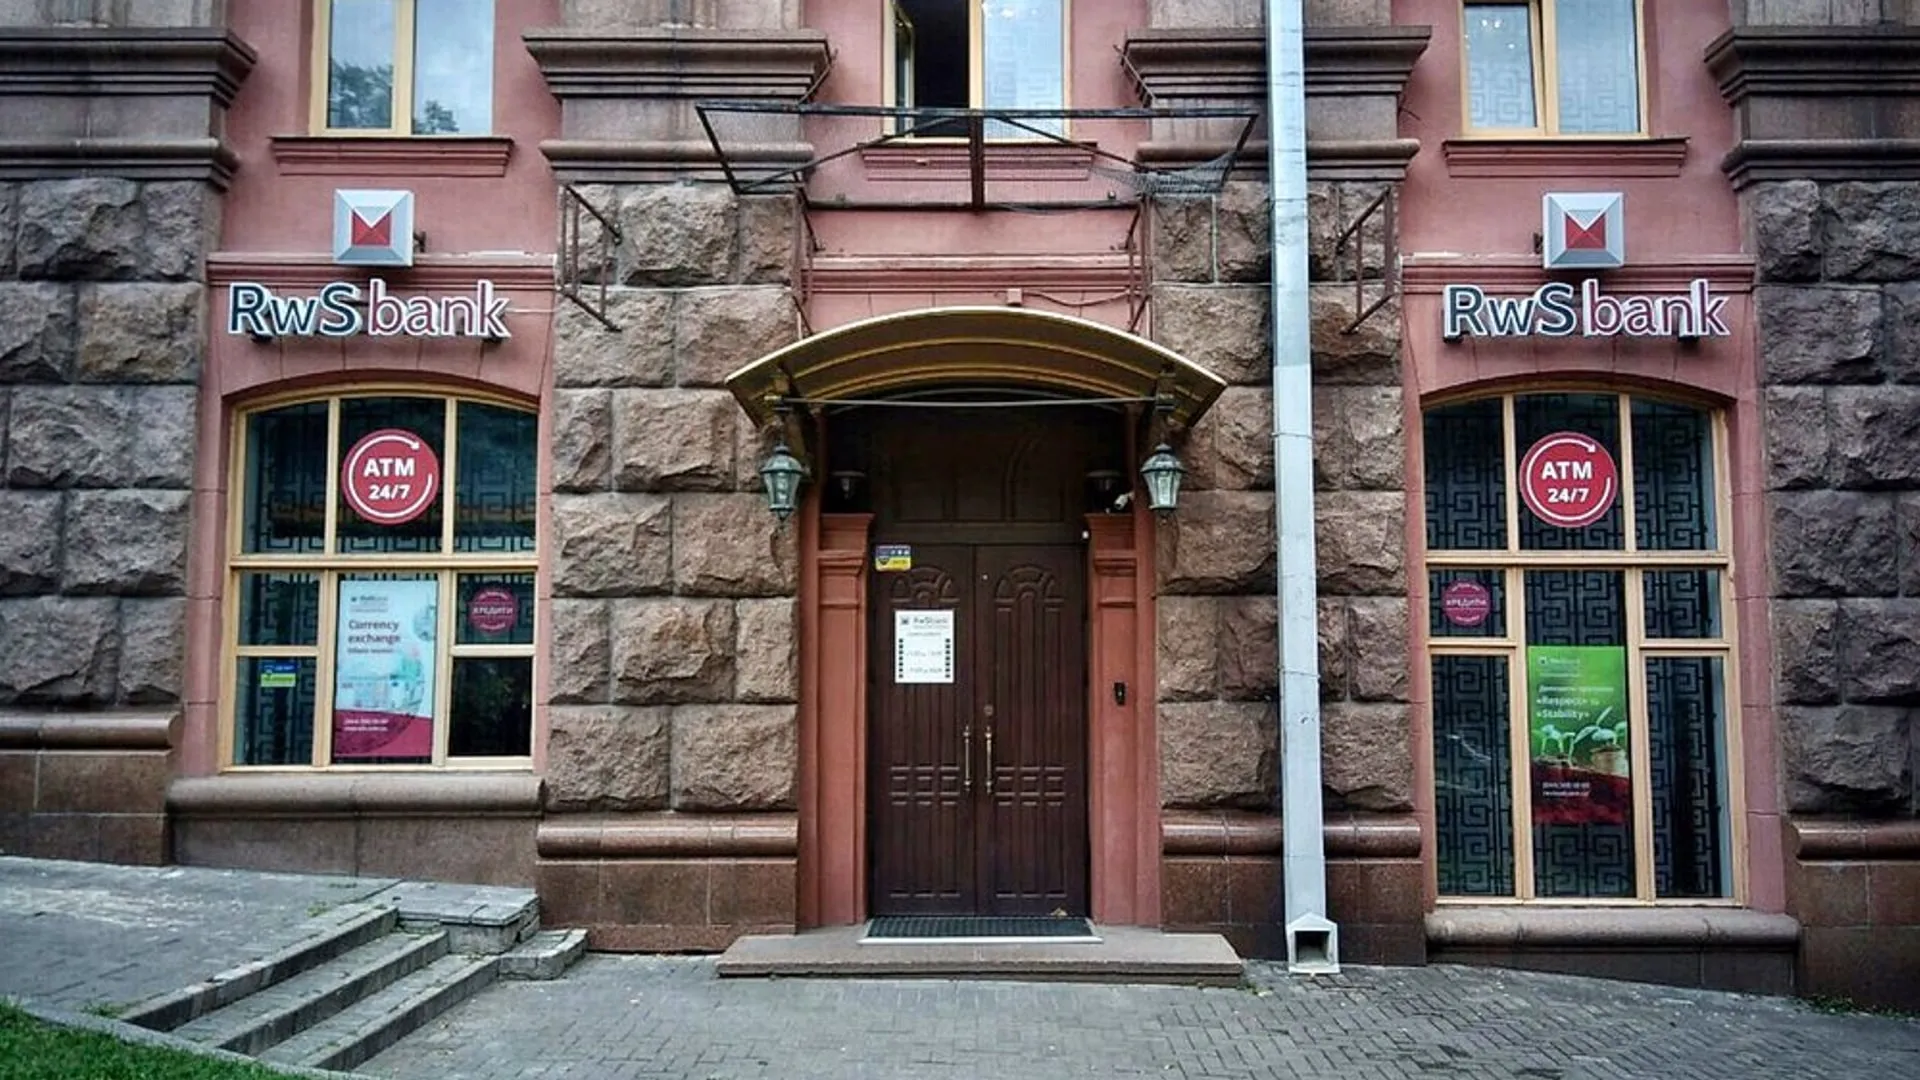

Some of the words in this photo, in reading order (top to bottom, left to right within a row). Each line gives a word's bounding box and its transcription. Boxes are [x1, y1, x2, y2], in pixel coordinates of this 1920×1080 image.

[363, 457, 415, 477] ATM
[1541, 461, 1593, 480] ATM
[368, 484, 411, 500] 24/7
[1547, 488, 1590, 503] 24/7
[348, 620, 399, 633] Currency
[348, 634, 401, 646] exchange
